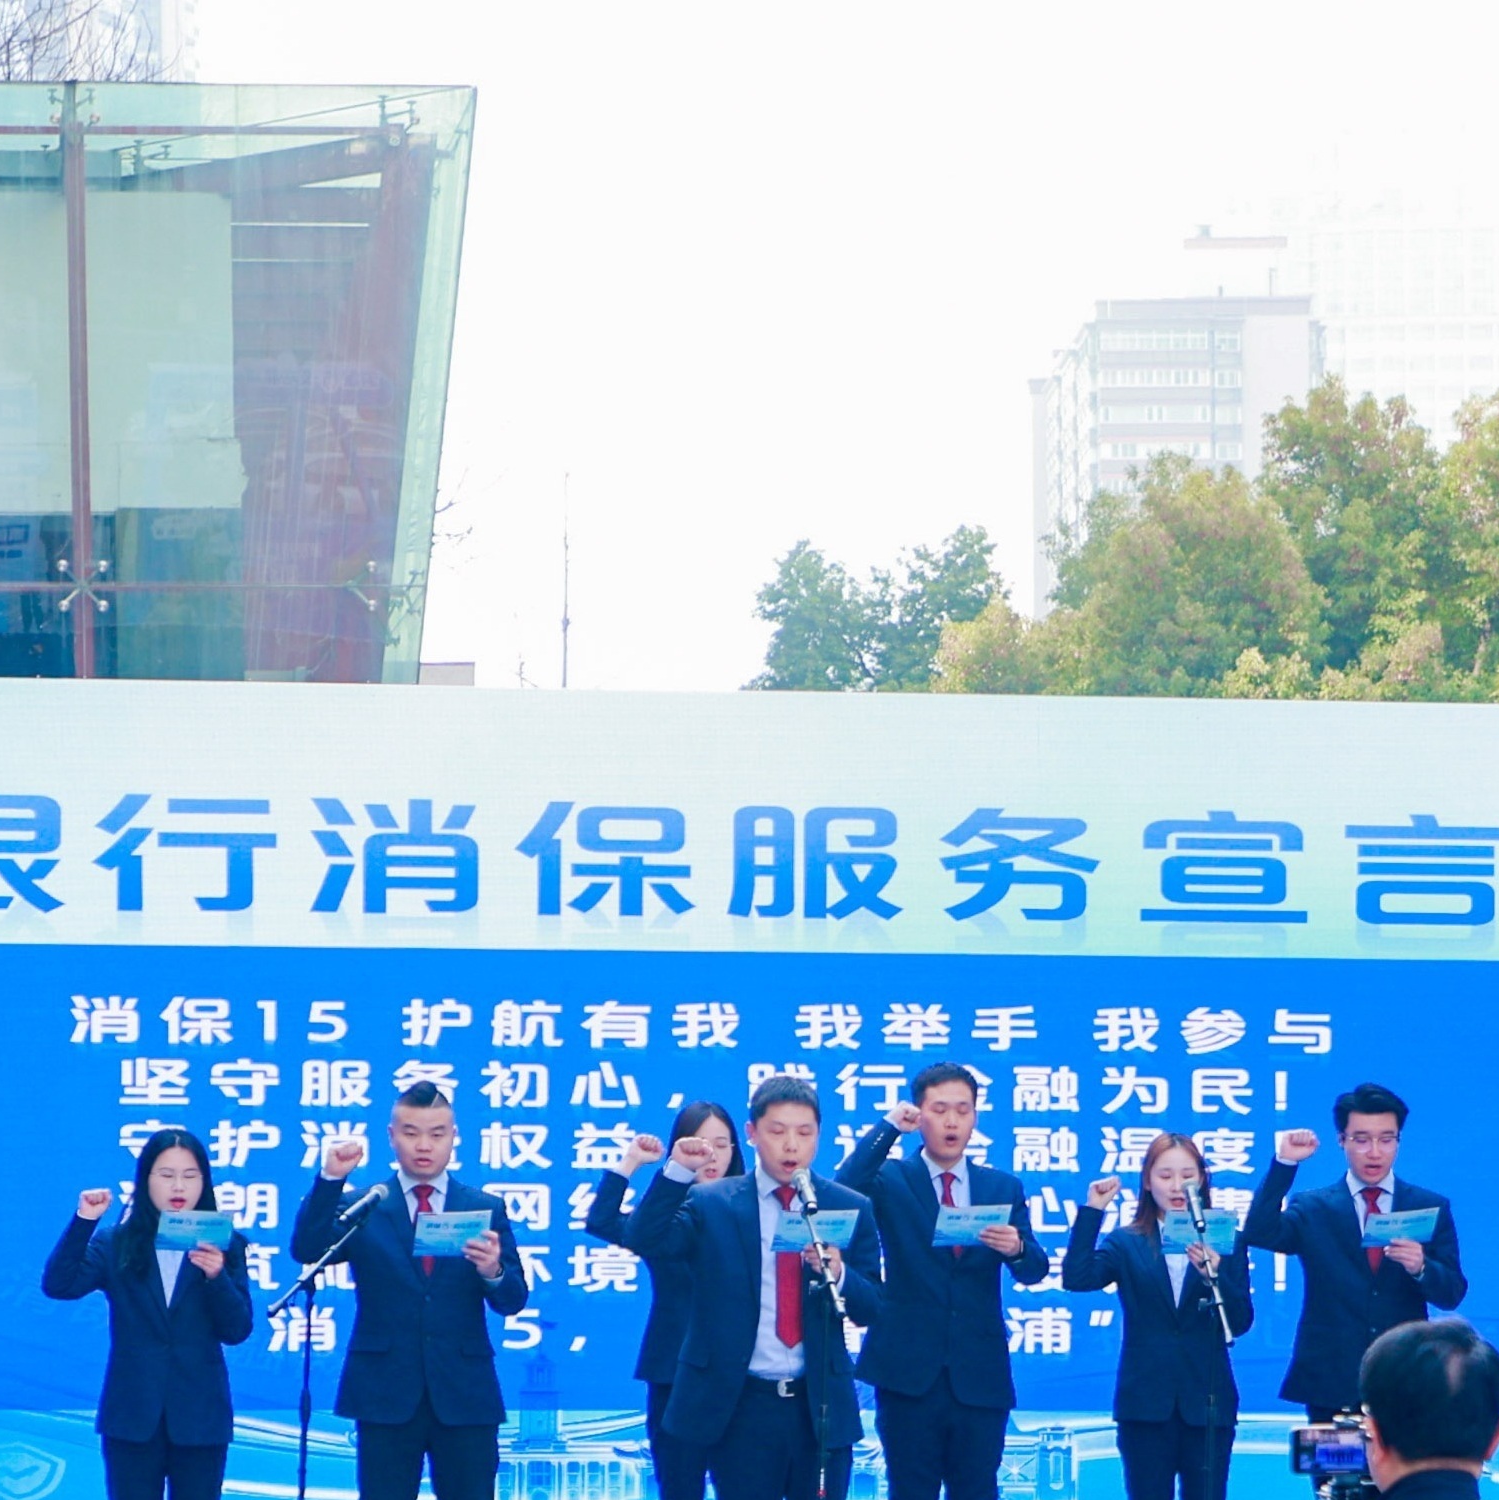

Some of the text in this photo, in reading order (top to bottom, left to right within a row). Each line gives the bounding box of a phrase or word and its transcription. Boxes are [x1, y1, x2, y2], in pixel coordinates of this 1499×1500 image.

[69, 994, 1334, 1055] 消保15 护航有我 我举手 我参与
